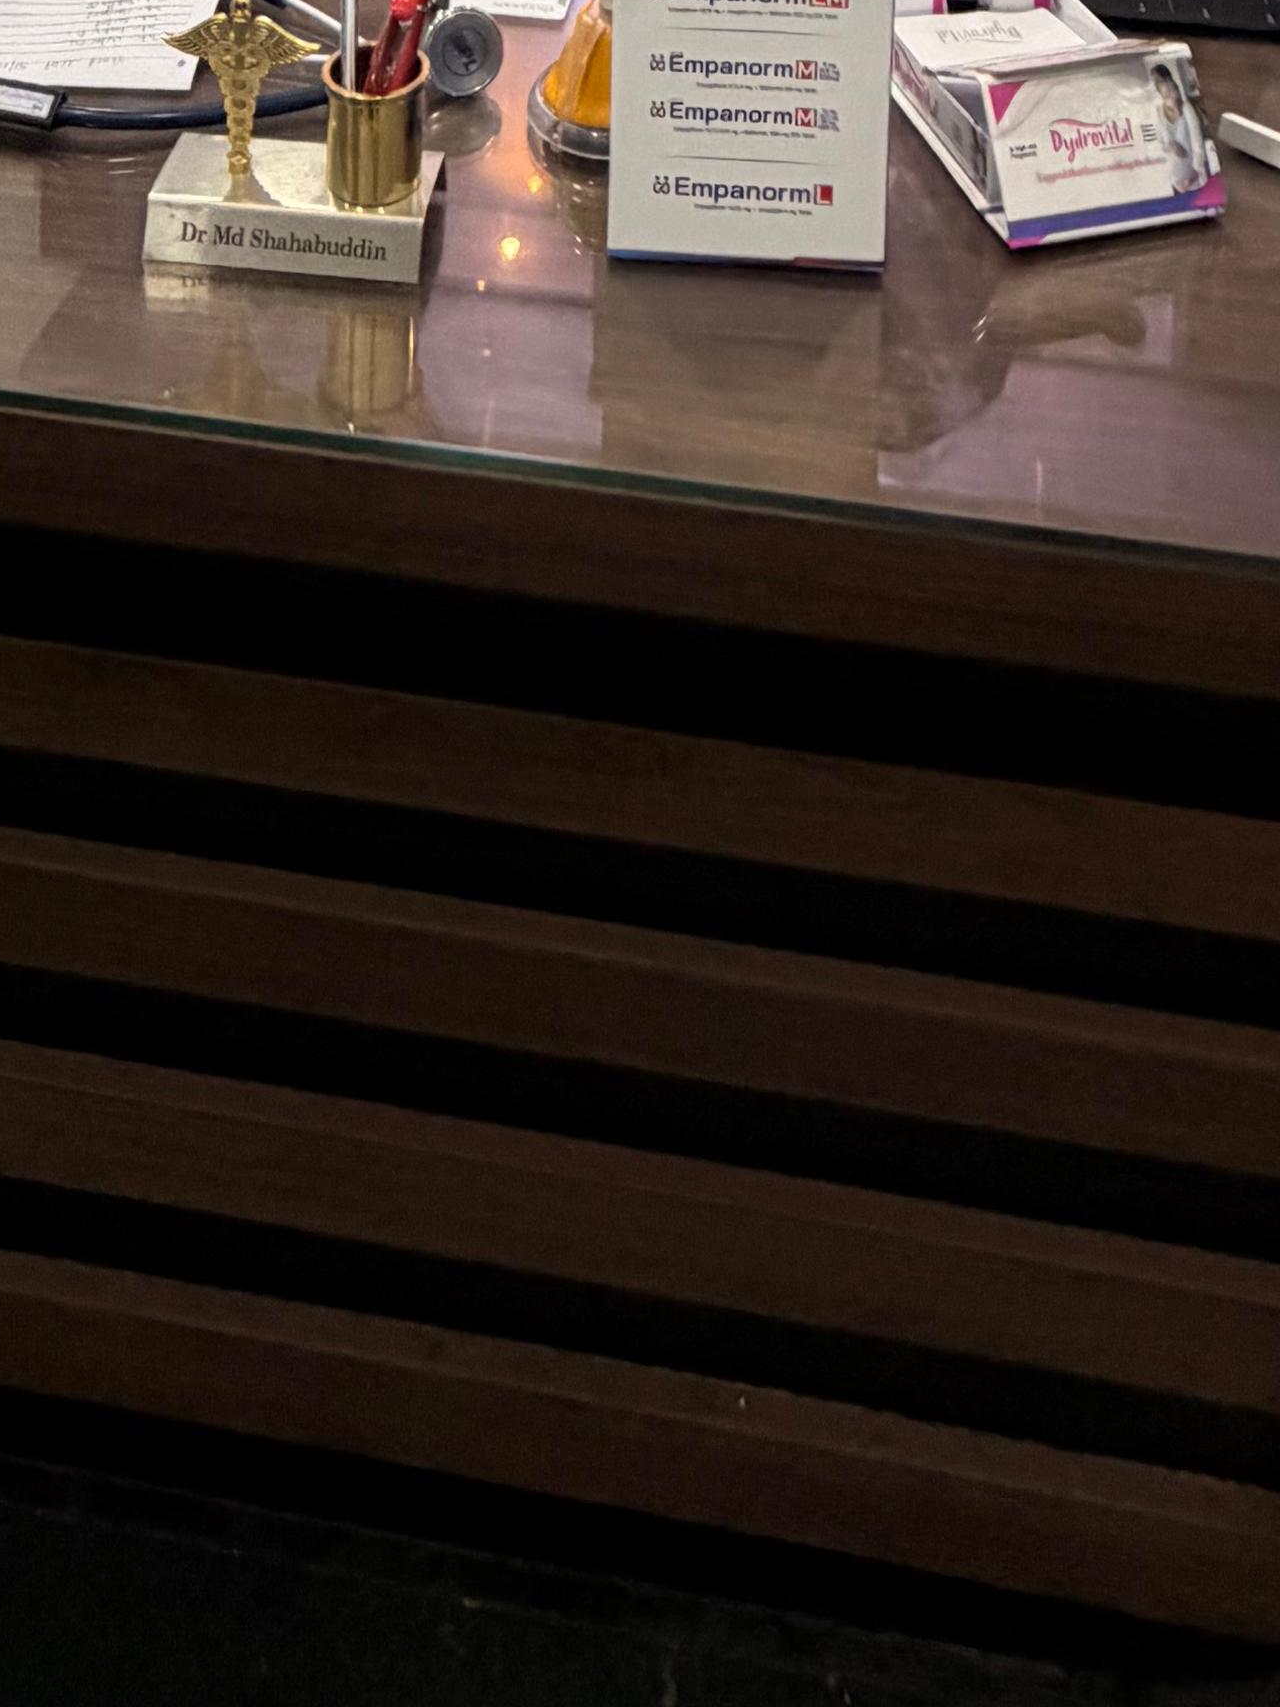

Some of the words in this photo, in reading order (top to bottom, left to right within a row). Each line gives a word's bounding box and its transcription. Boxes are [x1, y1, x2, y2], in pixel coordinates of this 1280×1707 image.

[669, 52, 794, 78] Empanorm
[669, 101, 793, 127] Empanorm
[674, 176, 811, 204] Empanorm
[180, 220, 208, 243] Dr
[214, 224, 246, 248] Md
[248, 228, 388, 261] Shahabuddin
